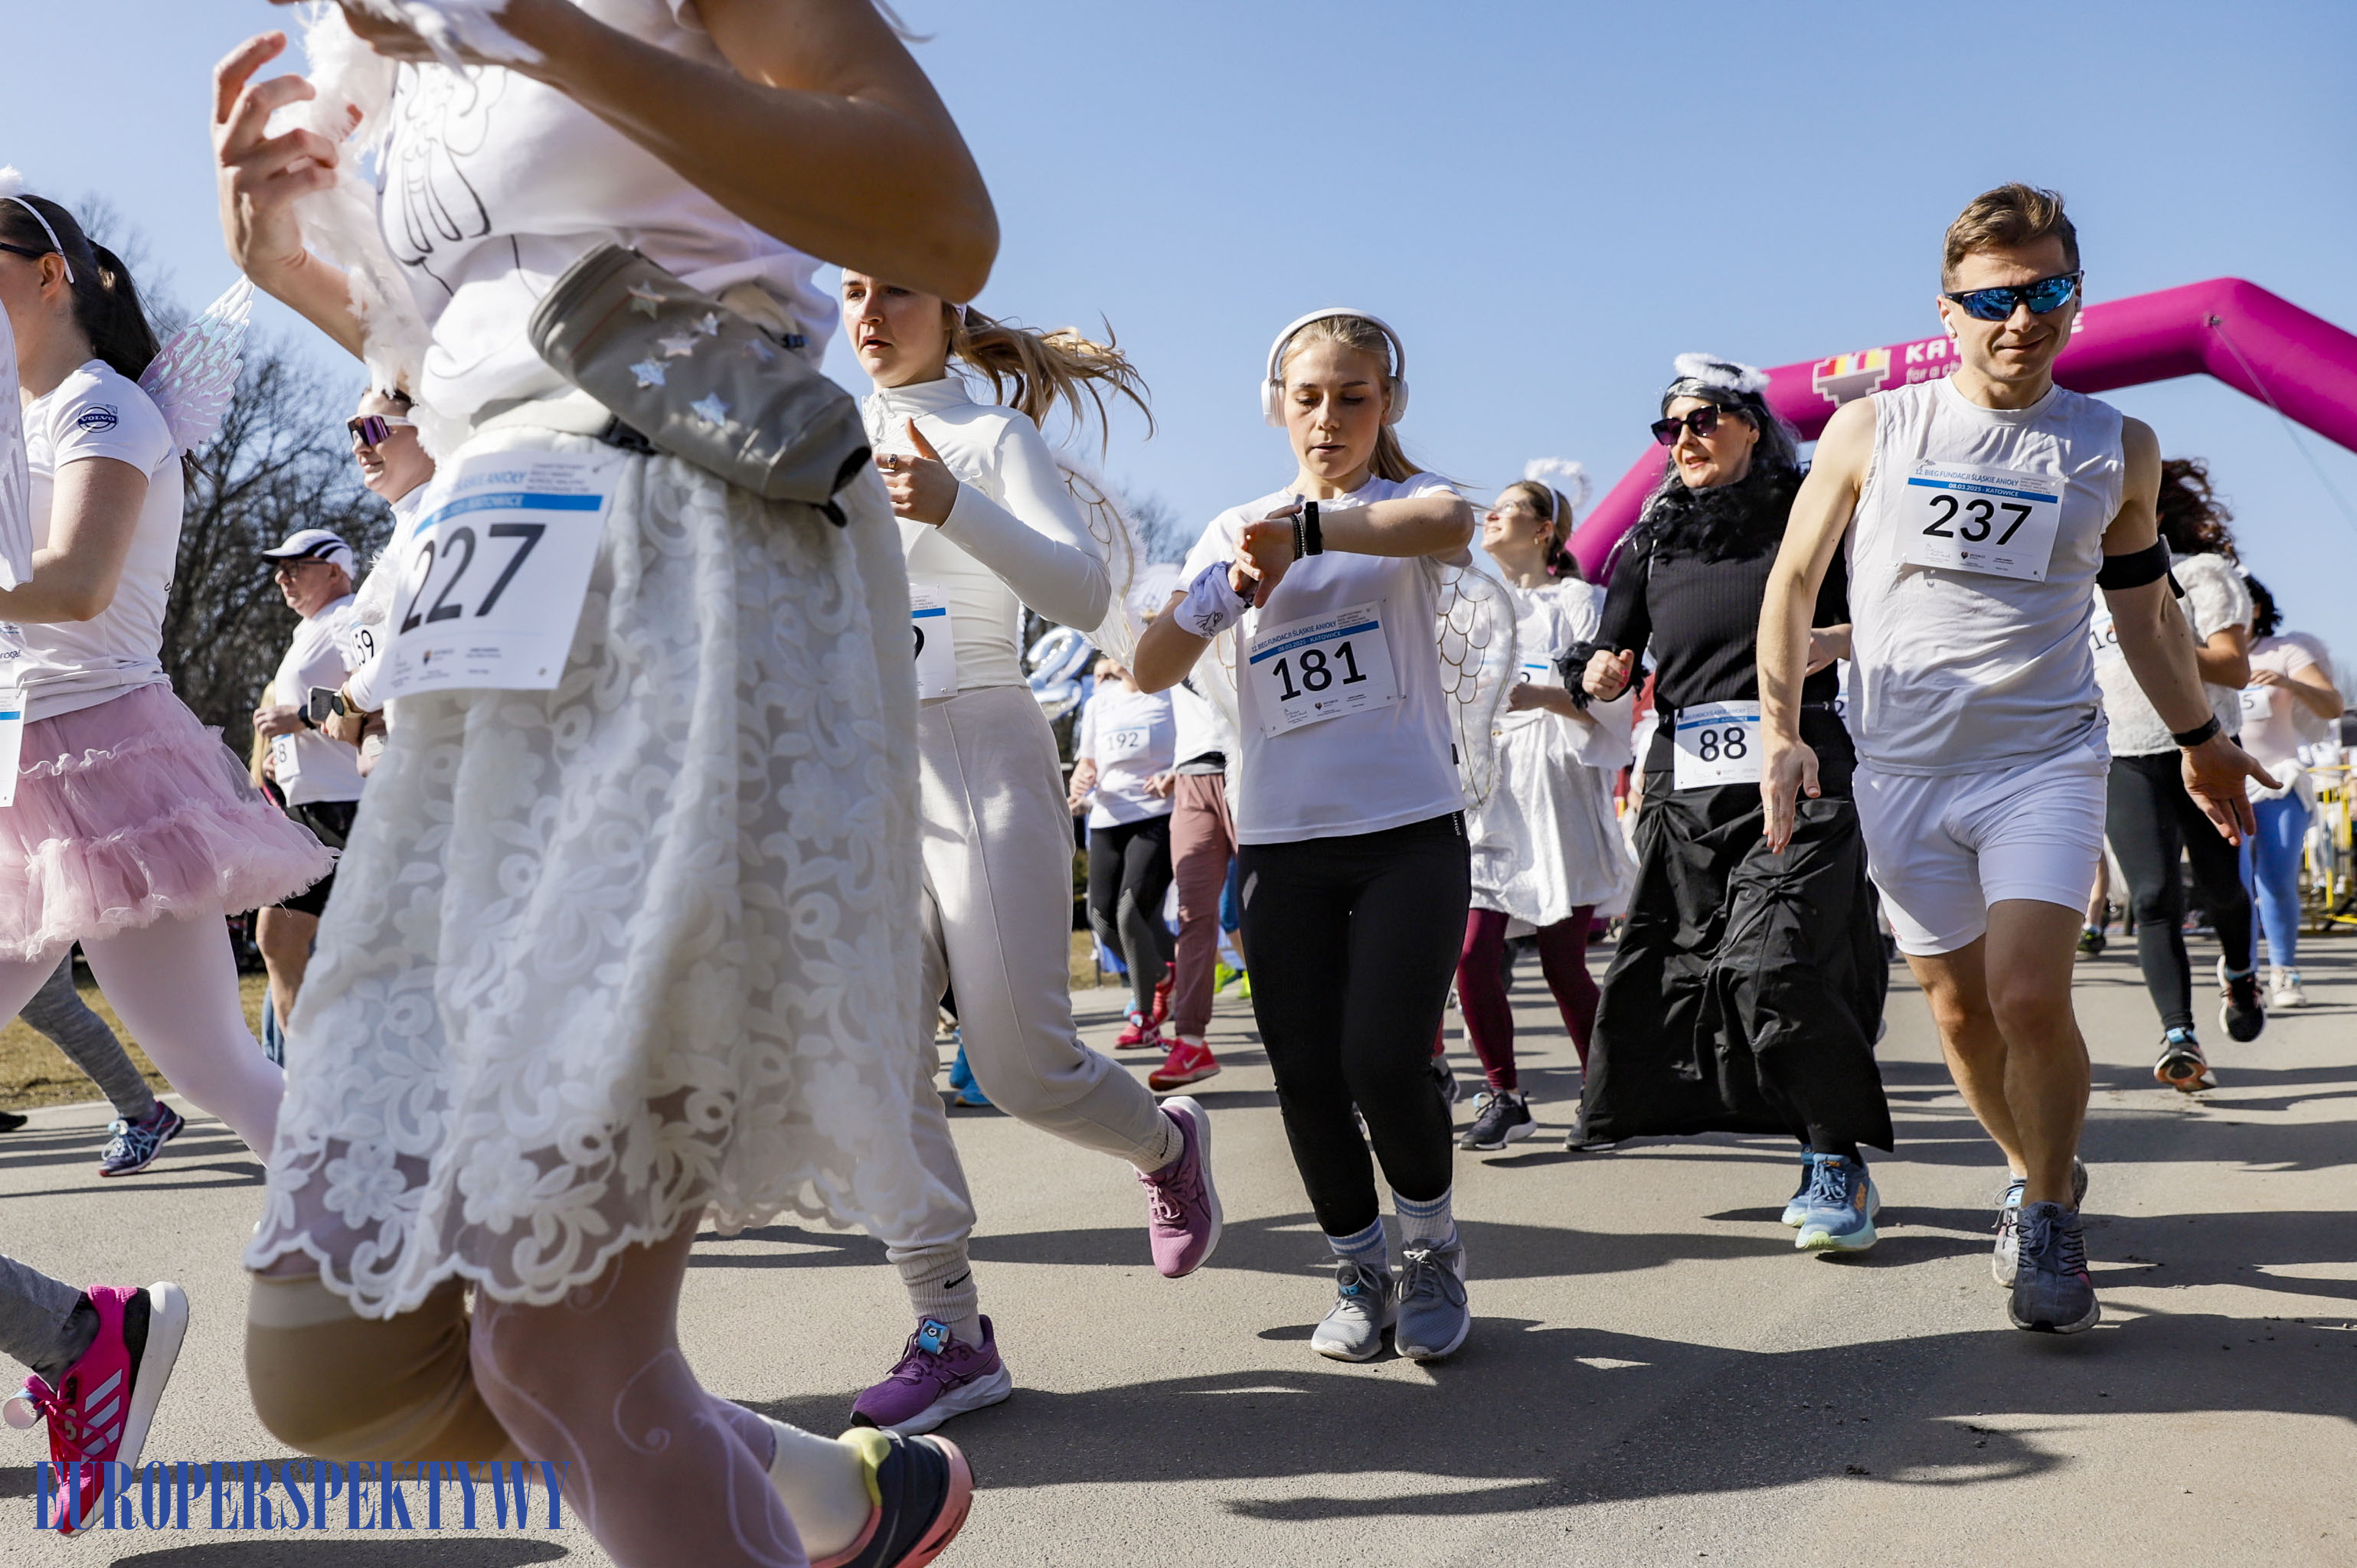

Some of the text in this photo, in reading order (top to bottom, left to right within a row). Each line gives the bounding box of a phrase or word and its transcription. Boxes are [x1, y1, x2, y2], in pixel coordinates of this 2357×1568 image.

[1905, 338, 1960, 364] KAT
[1924, 469, 1940, 477] BIEG
[1940, 470, 1970, 481] FUNDACJI
[1970, 471, 1996, 484] ŚLĄSKIE
[1996, 477, 2019, 487] ANIOŁY
[1985, 488, 2019, 497] KATOWICE
[1923, 495, 2032, 545] 237
[399, 523, 547, 635] 227
[1258, 641, 1268, 651] BIEG
[1268, 633, 1292, 645] FUNDACJI
[1309, 631, 1342, 643] KATOWICE
[1273, 641, 1367, 701] 181
[1107, 732, 1139, 750] 192
[1700, 727, 1747, 762] 88
